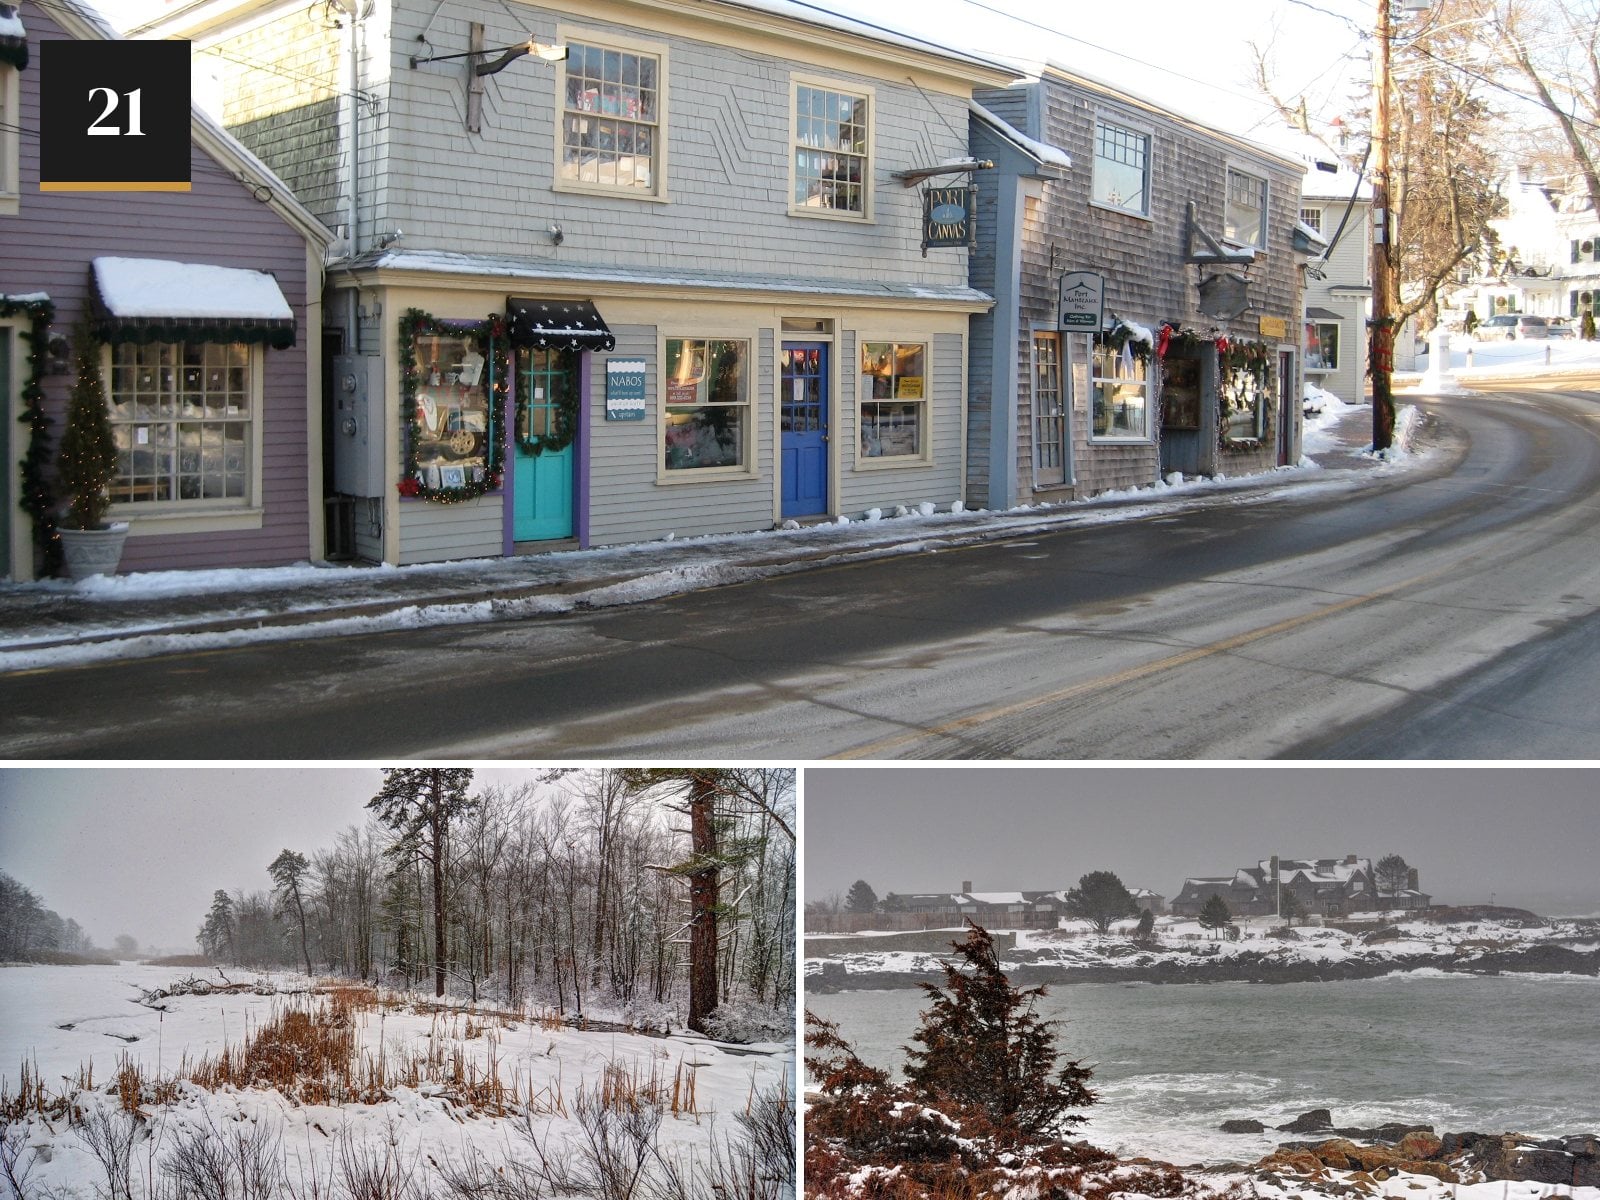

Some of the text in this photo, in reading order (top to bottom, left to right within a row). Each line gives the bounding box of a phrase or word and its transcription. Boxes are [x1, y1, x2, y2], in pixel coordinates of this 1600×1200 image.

[930, 188, 967, 210] PORT
[928, 219, 966, 240] CANVAS
[611, 376, 642, 387] NABOS
